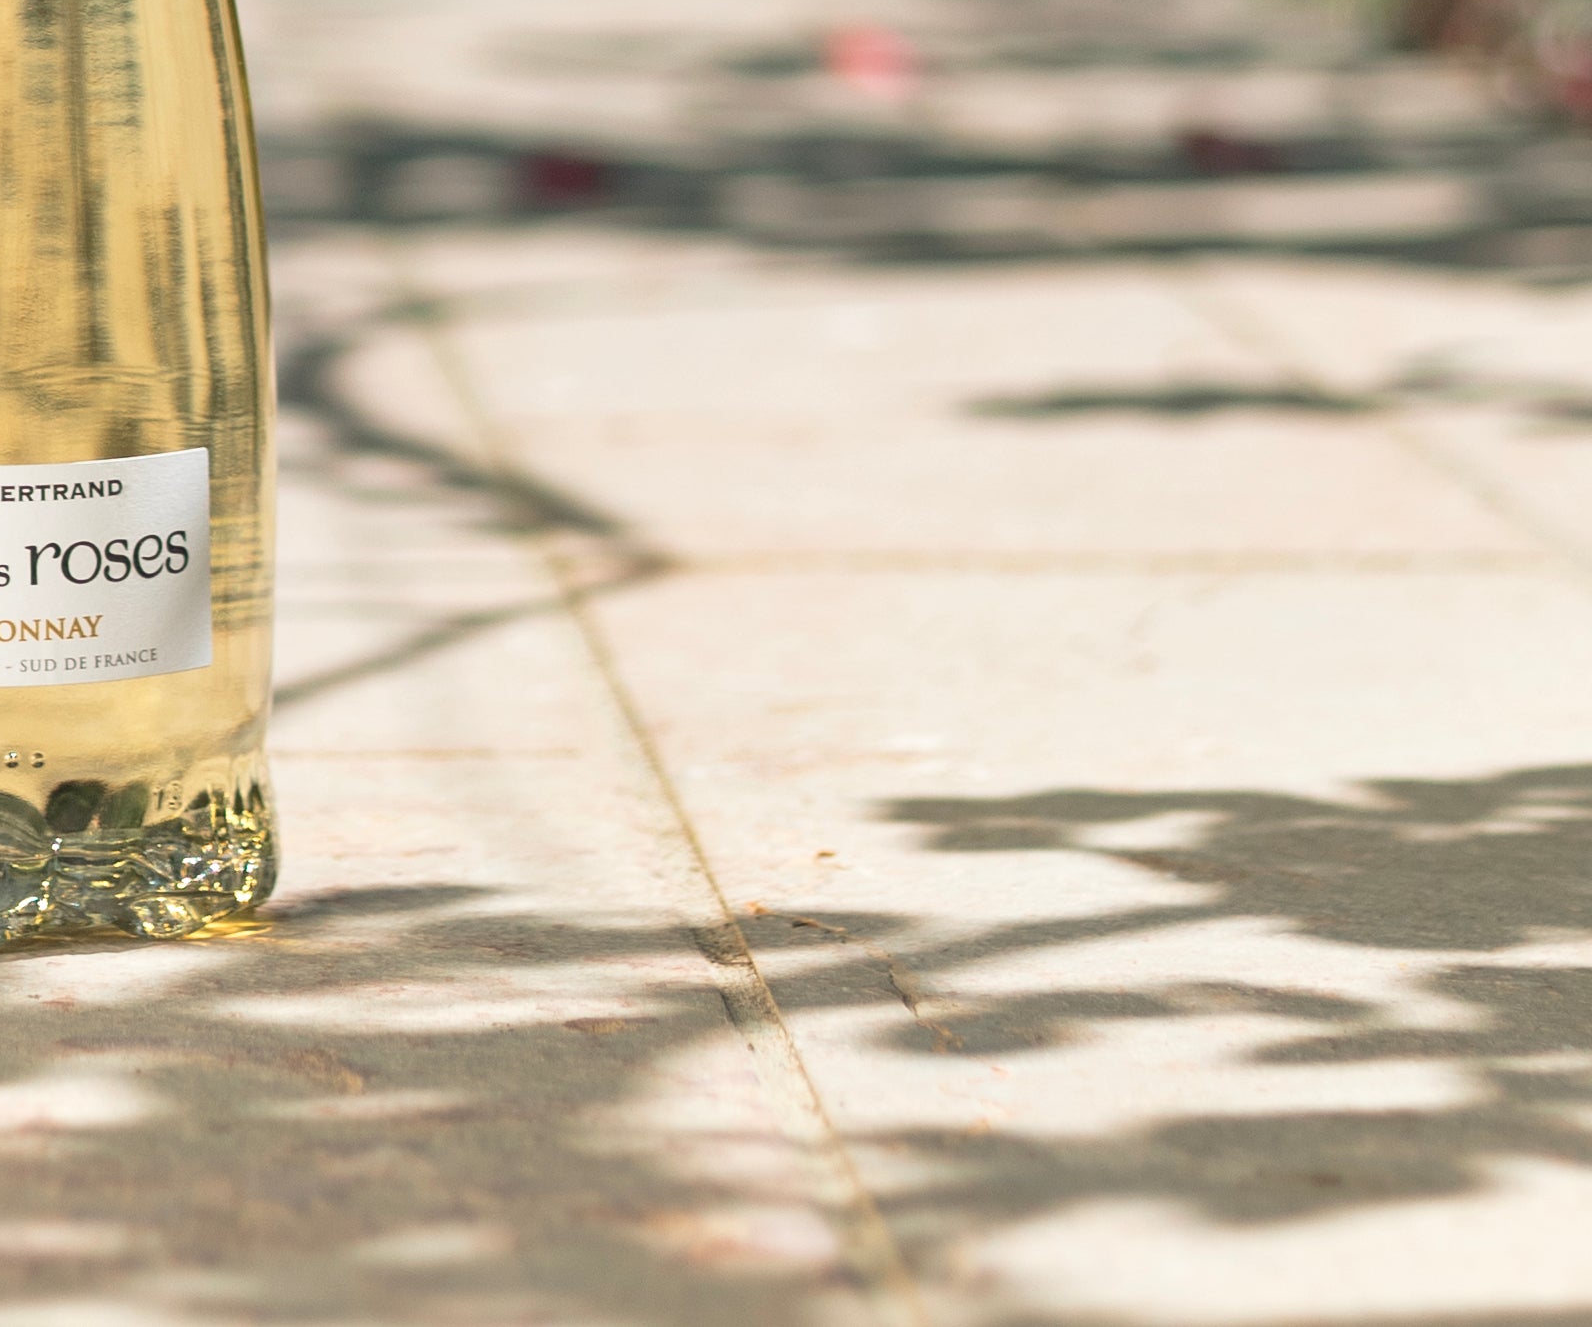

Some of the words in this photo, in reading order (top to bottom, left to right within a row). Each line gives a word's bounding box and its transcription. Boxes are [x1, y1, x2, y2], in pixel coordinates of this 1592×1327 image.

[24, 530, 190, 586] roses
[19, 658, 57, 673] SUD
[64, 656, 88, 671] DE
[94, 648, 158, 669] FRANCE
